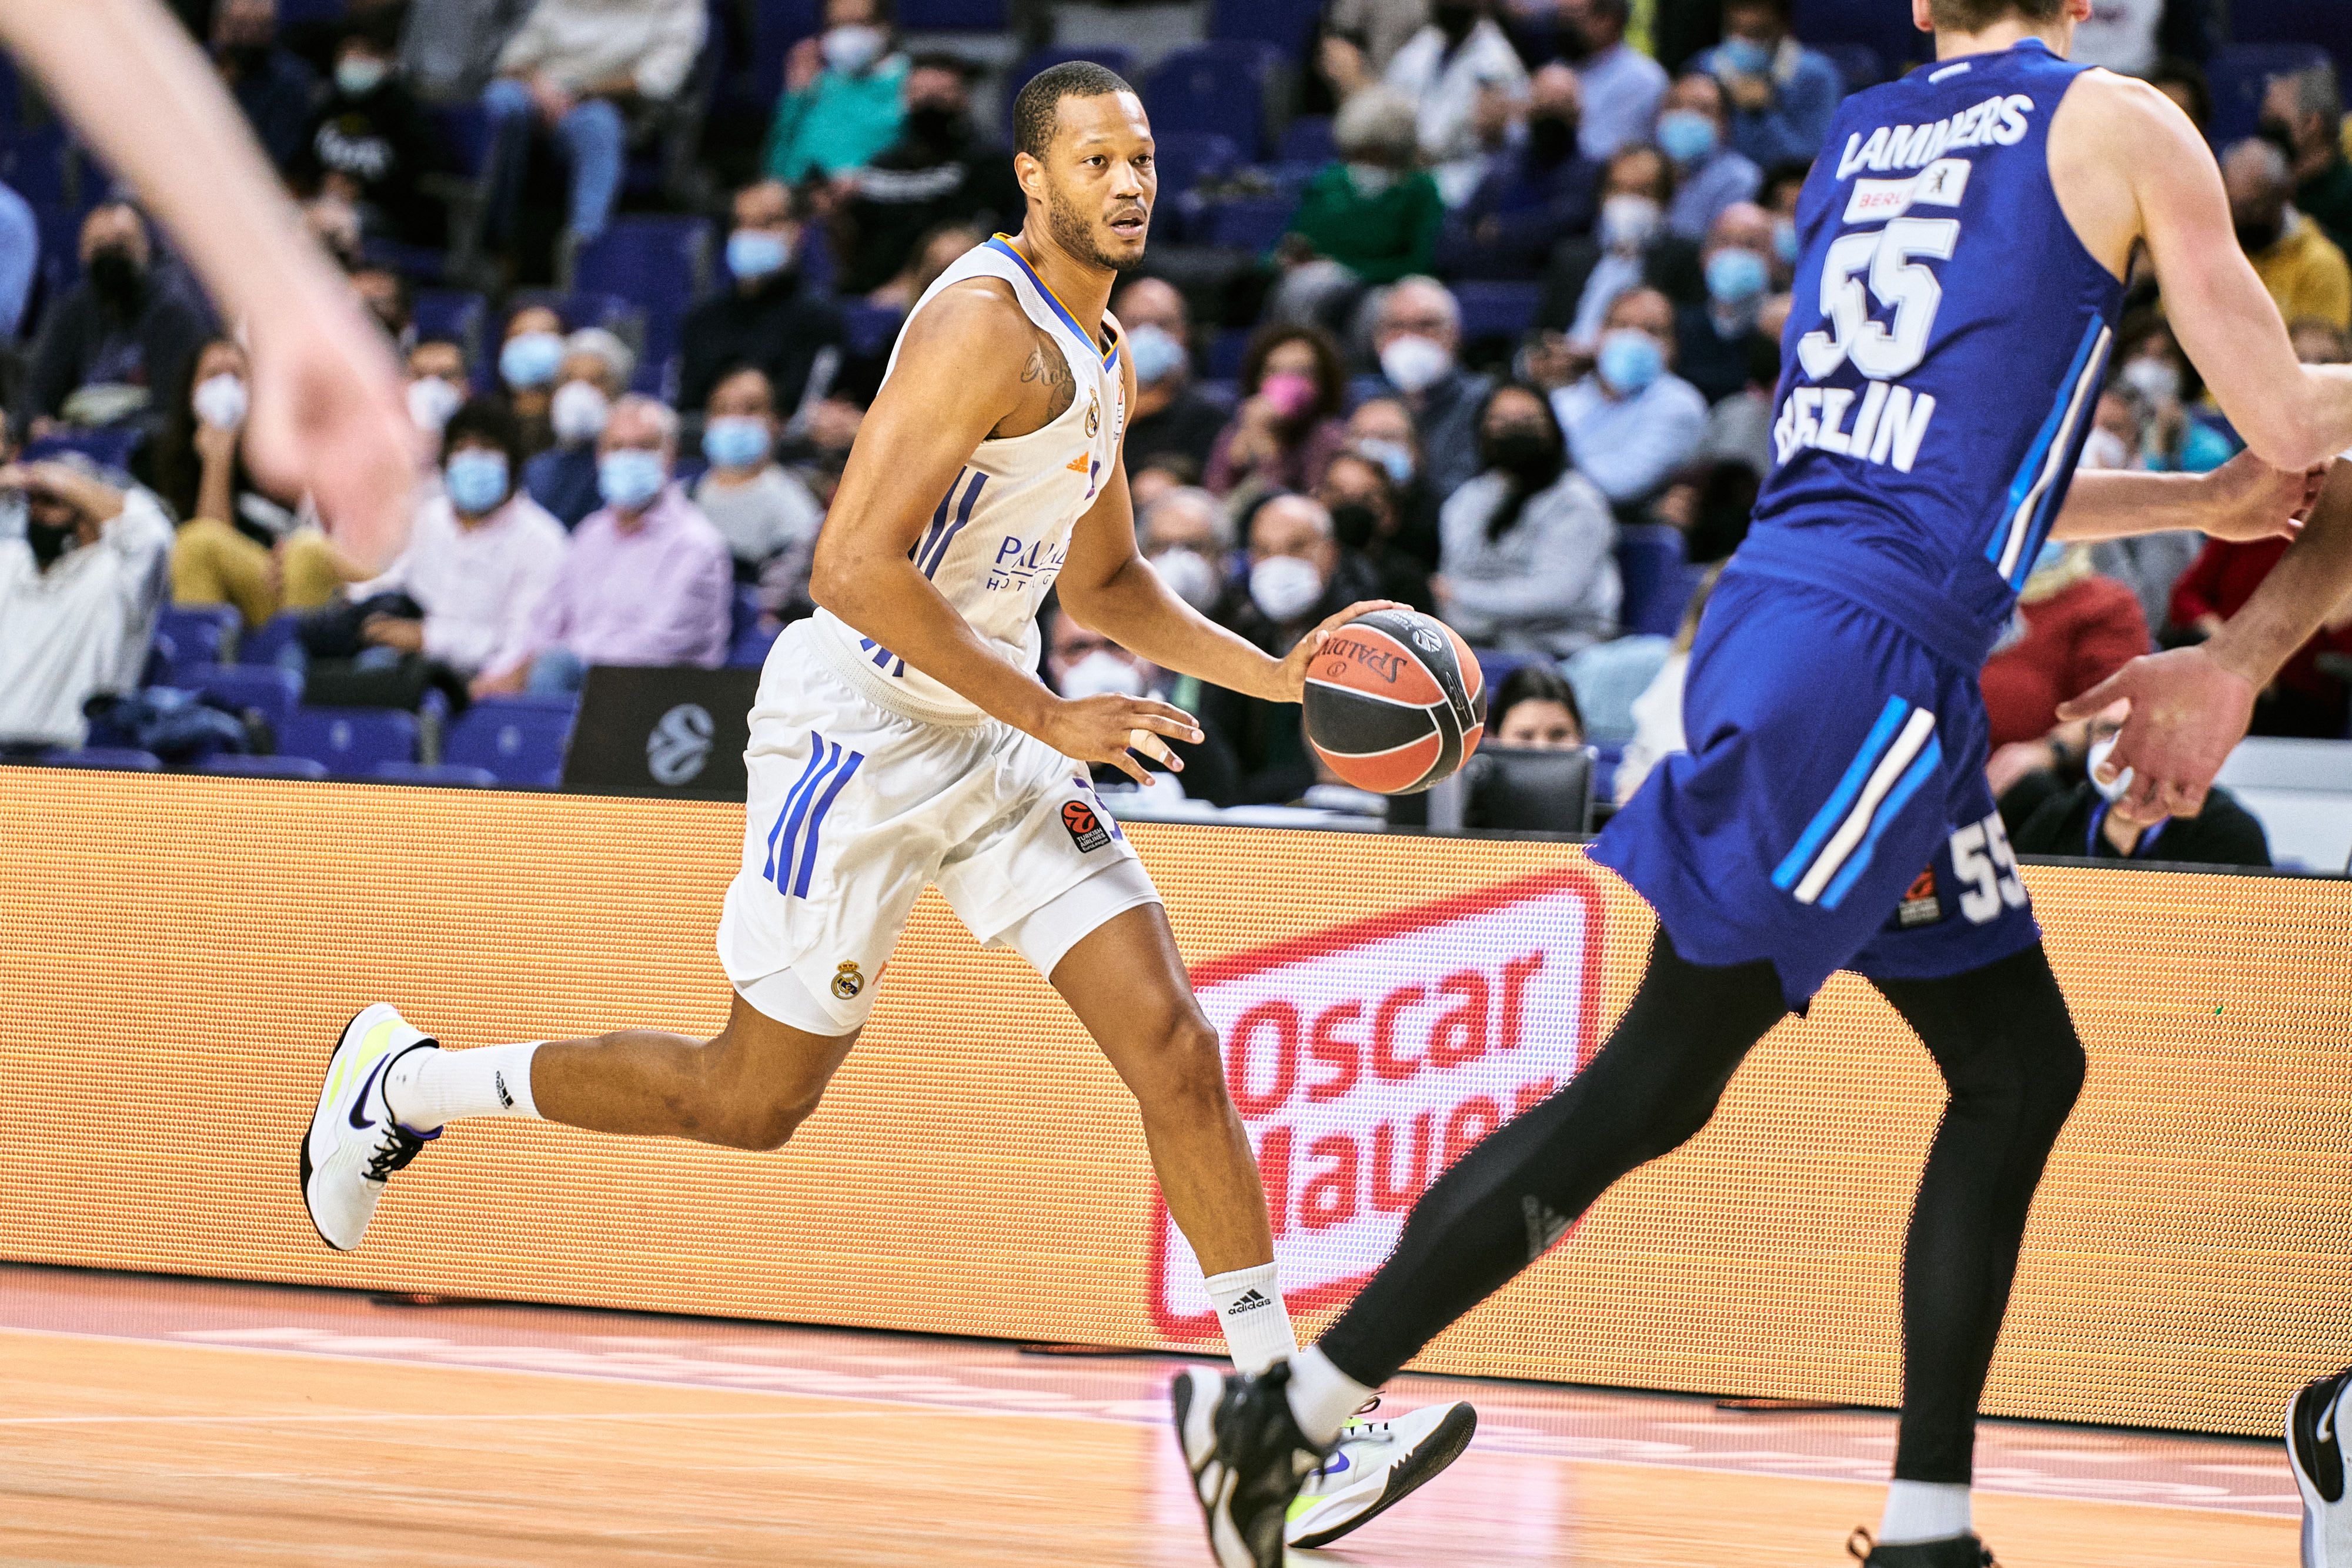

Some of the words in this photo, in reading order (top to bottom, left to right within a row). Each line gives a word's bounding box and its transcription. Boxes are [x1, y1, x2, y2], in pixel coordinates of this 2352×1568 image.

[1859, 192, 1915, 209] BERL
[1798, 218, 1960, 381] 55
[1317, 638, 1408, 684] SPALDIN
[1077, 827, 1103, 842] TURKISH
[1080, 833, 1106, 848] AIRLINES
[1949, 810, 2029, 924] 55
[1228, 950, 1545, 1121] Oscar
[1228, 1298, 1271, 1315] adidas
